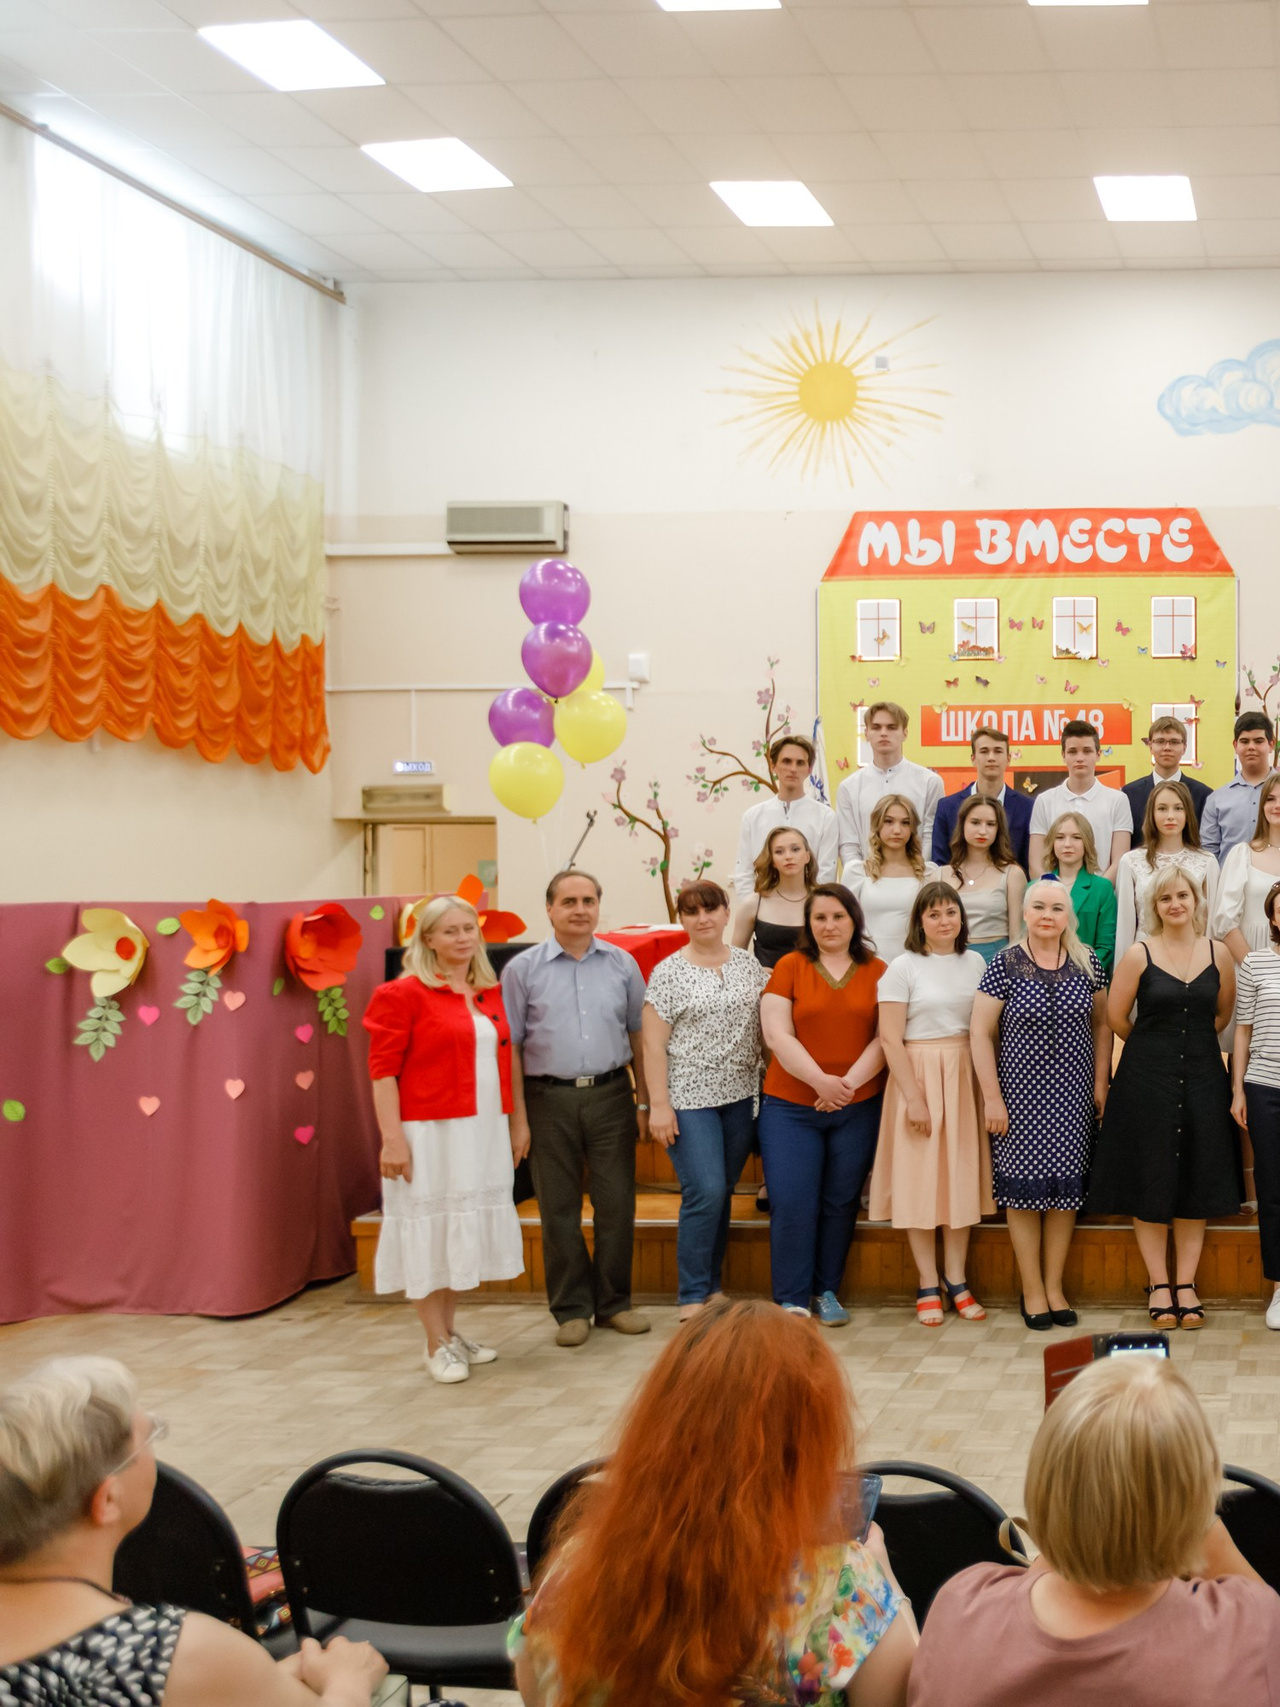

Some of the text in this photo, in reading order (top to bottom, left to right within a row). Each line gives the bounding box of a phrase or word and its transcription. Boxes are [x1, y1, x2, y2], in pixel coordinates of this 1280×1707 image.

[858, 517, 1194, 567] МЫ ВМЕСТЕ
[941, 710, 1036, 742] ШКОЛА
[396, 761, 431, 771] ЫХОД
